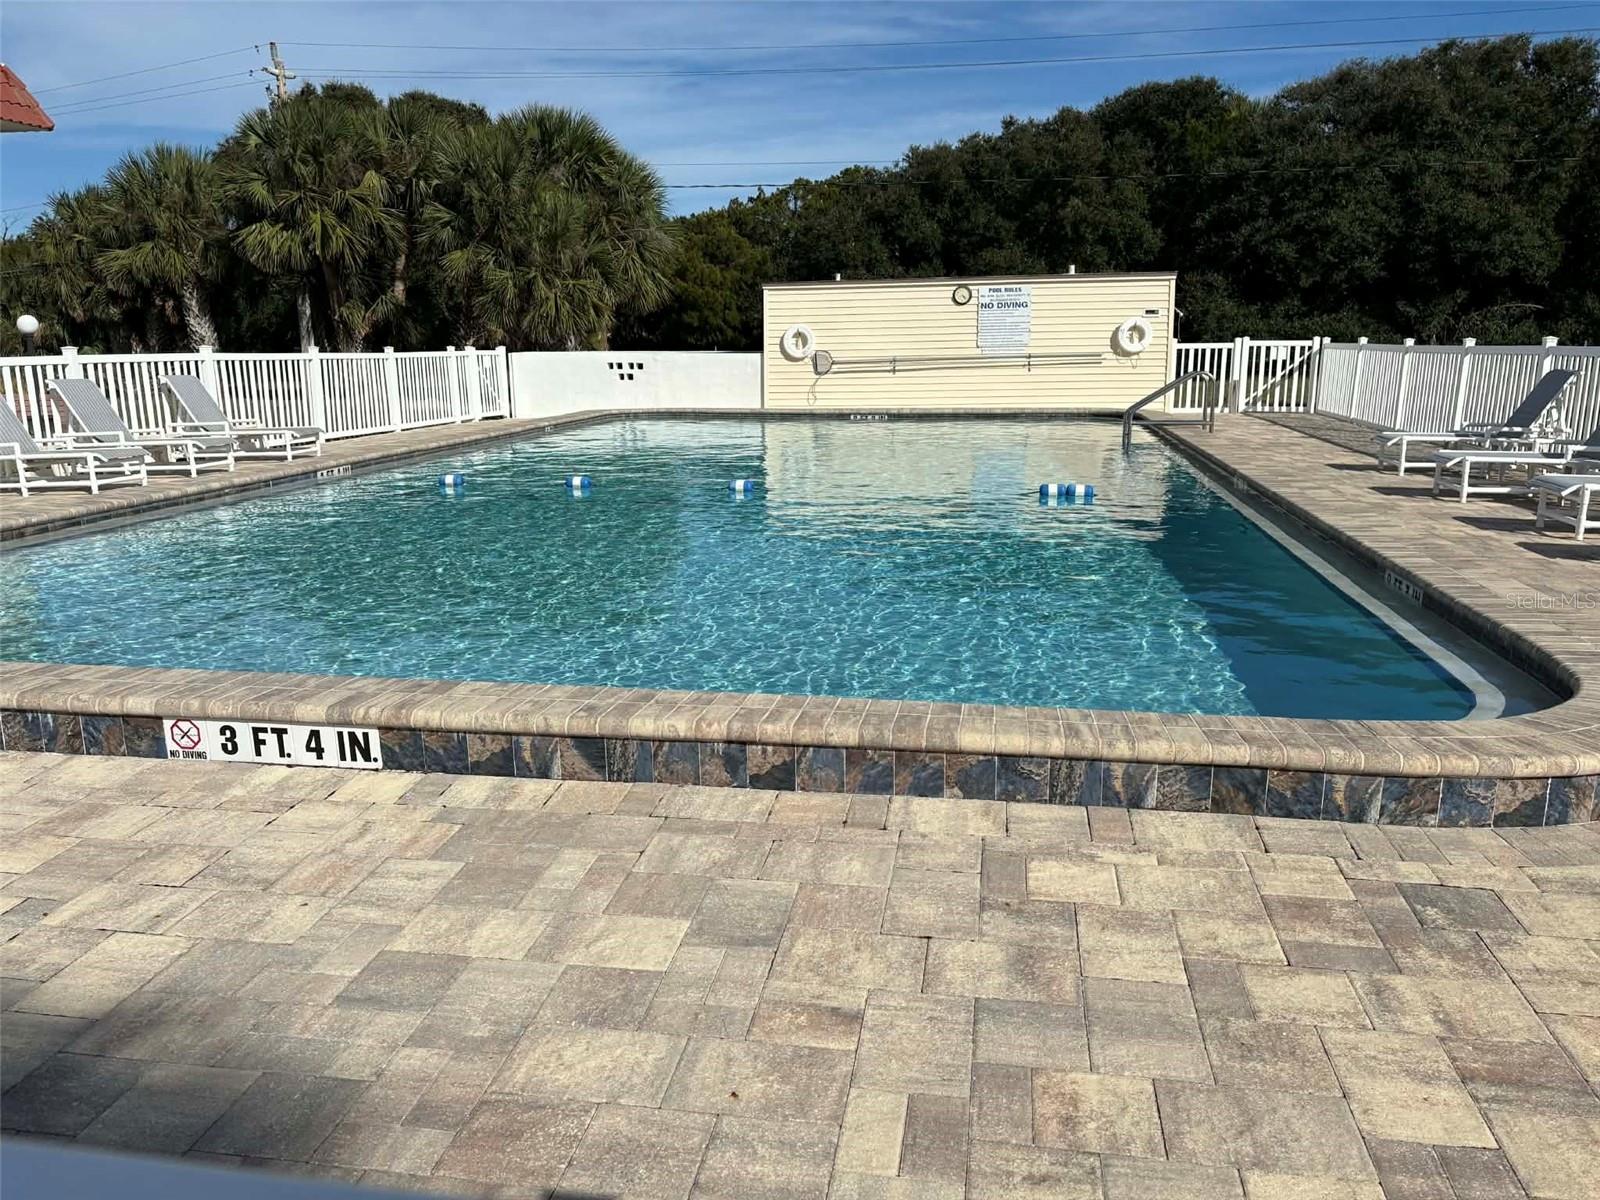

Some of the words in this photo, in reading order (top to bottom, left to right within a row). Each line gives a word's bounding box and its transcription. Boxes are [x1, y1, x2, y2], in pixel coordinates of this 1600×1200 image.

[996, 301, 1028, 309] DIVING
[219, 725, 239, 755] 3
[251, 726, 292, 758] FT.
[305, 729, 325, 760] 4
[337, 731, 379, 763] IN.
[169, 749, 181, 759] NO
[182, 750, 208, 760] DIVING
